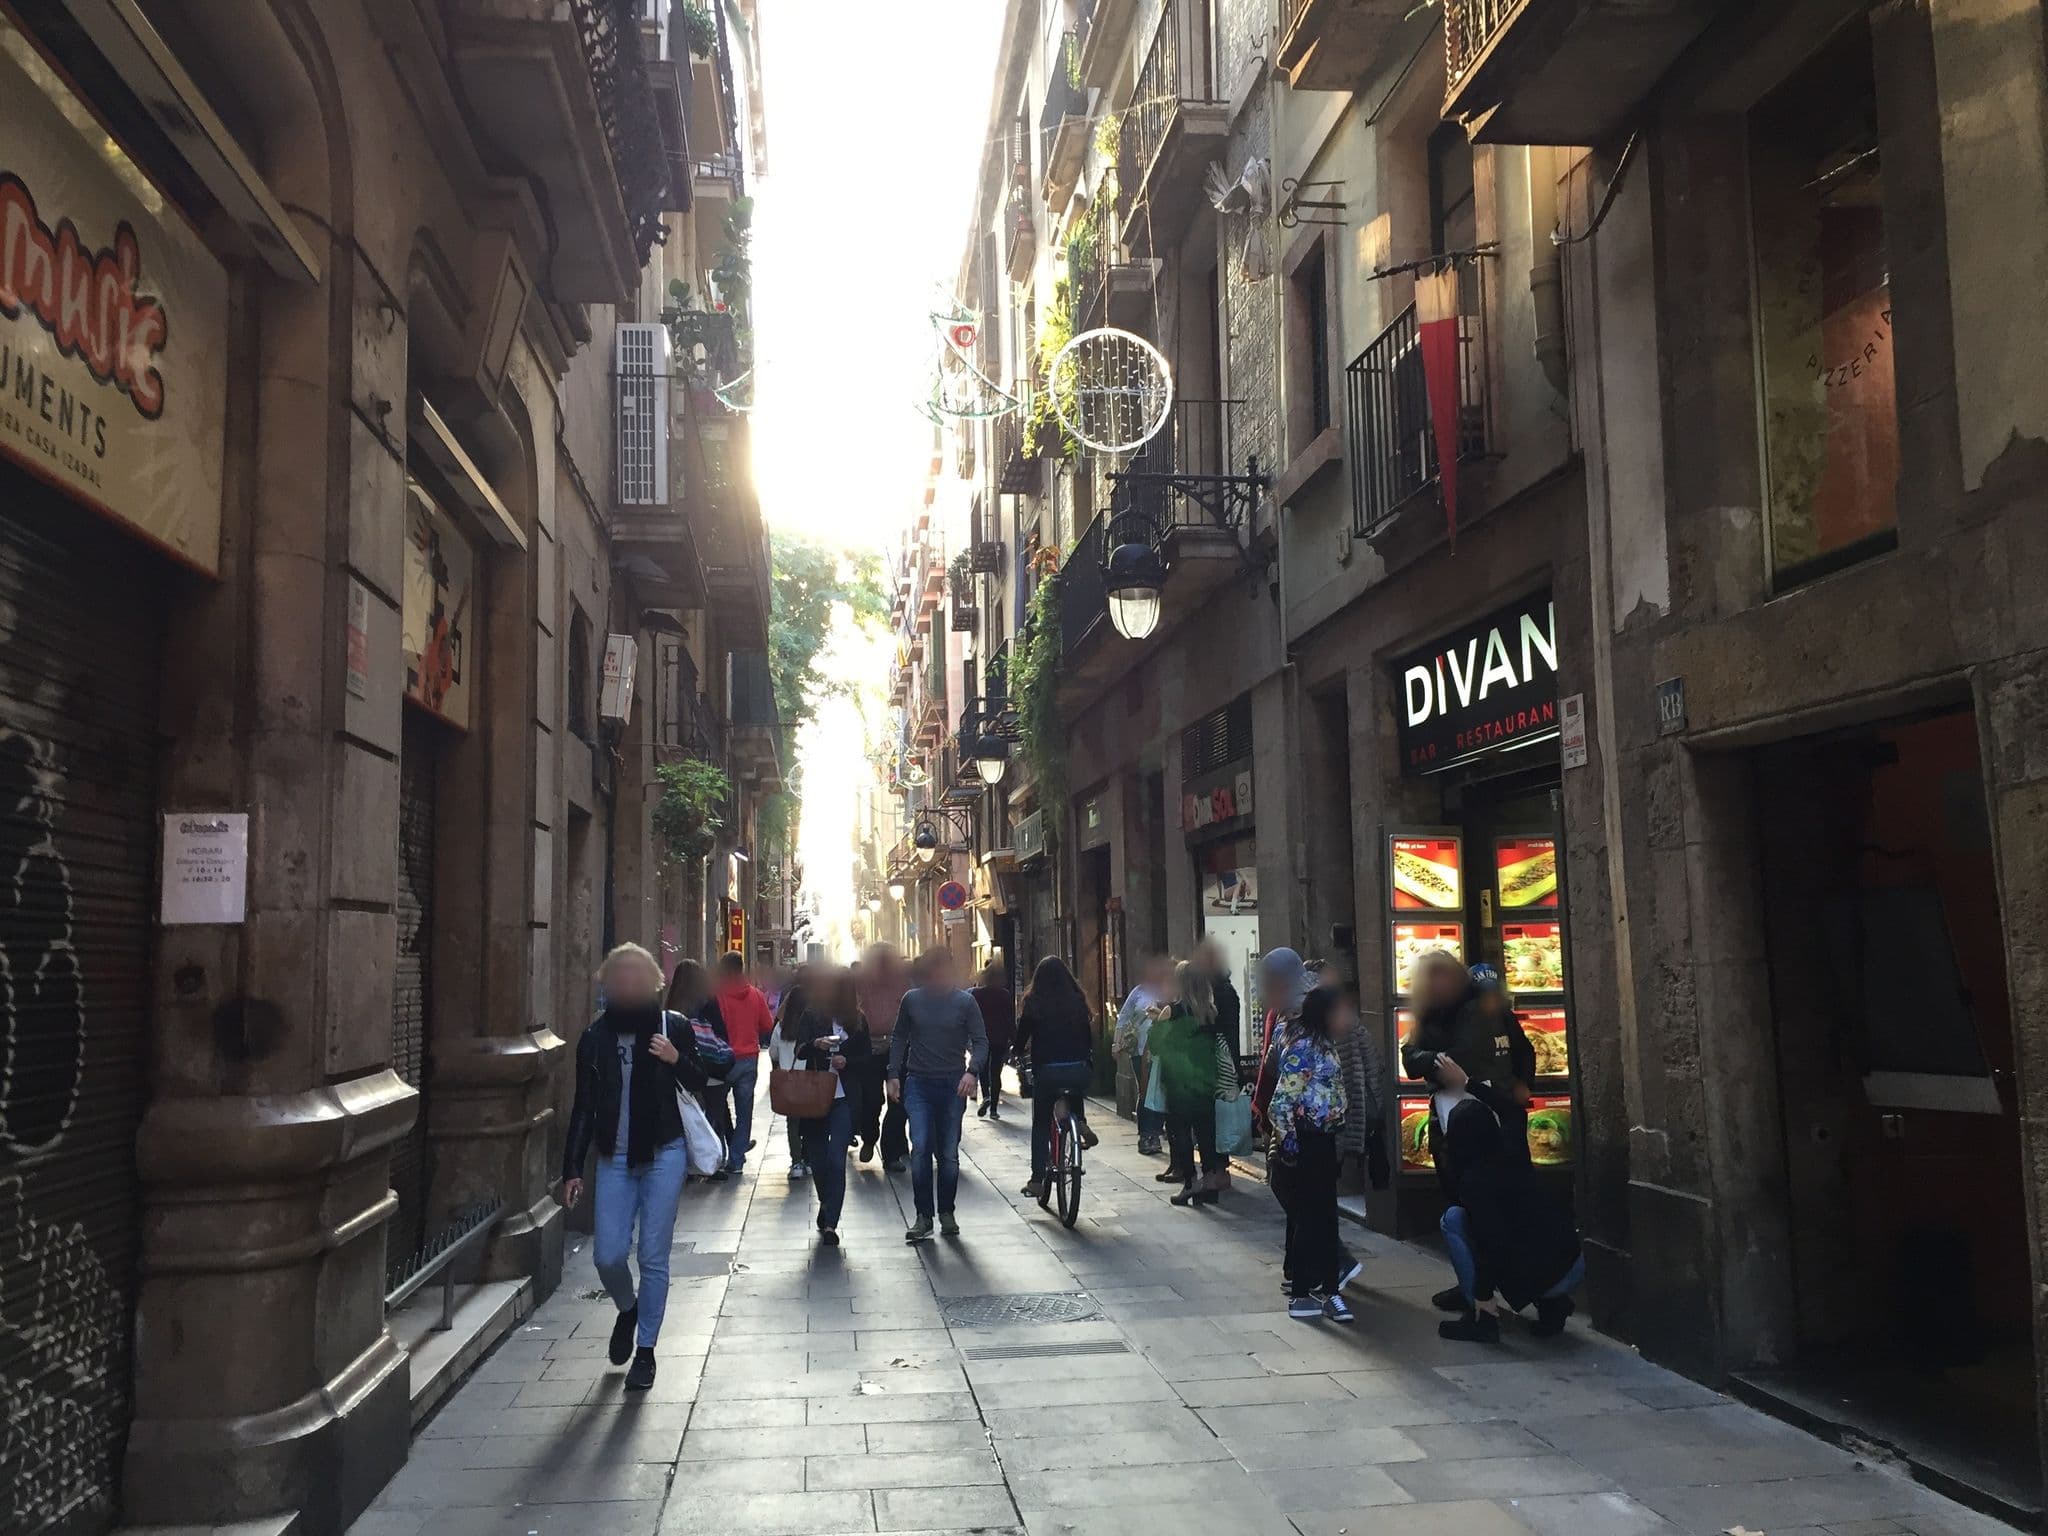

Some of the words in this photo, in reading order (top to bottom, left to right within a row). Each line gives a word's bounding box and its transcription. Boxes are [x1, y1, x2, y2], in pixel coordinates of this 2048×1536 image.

[1806, 309, 1892, 388] PIZZERIA
[1405, 601, 1558, 727] DIVAN
[1410, 743, 1437, 765] BAR
